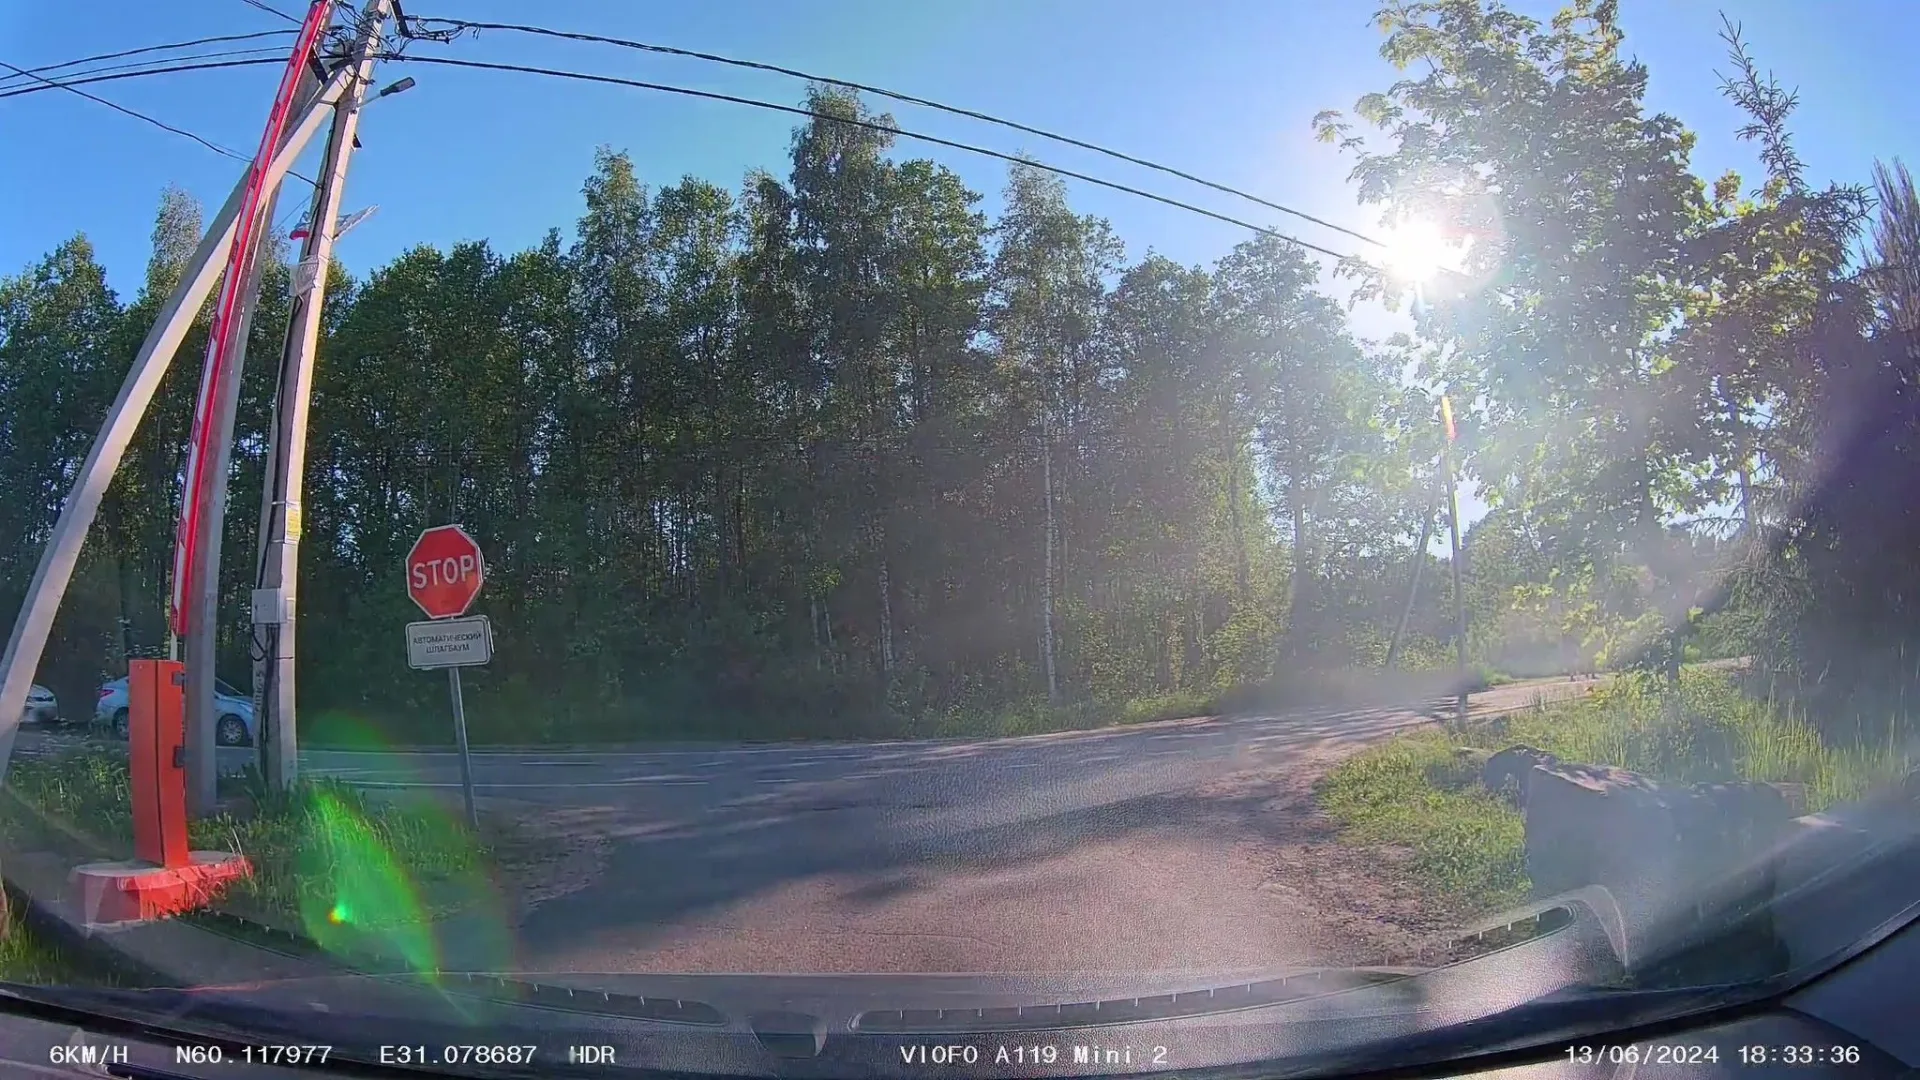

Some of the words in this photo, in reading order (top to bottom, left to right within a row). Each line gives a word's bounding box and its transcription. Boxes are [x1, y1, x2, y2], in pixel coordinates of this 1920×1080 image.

[413, 554, 474, 589] STOP
[413, 632, 481, 644] АВТОМАТИЧЕСКИЙ
[426, 643, 470, 653] ШЛАГБАУМ
